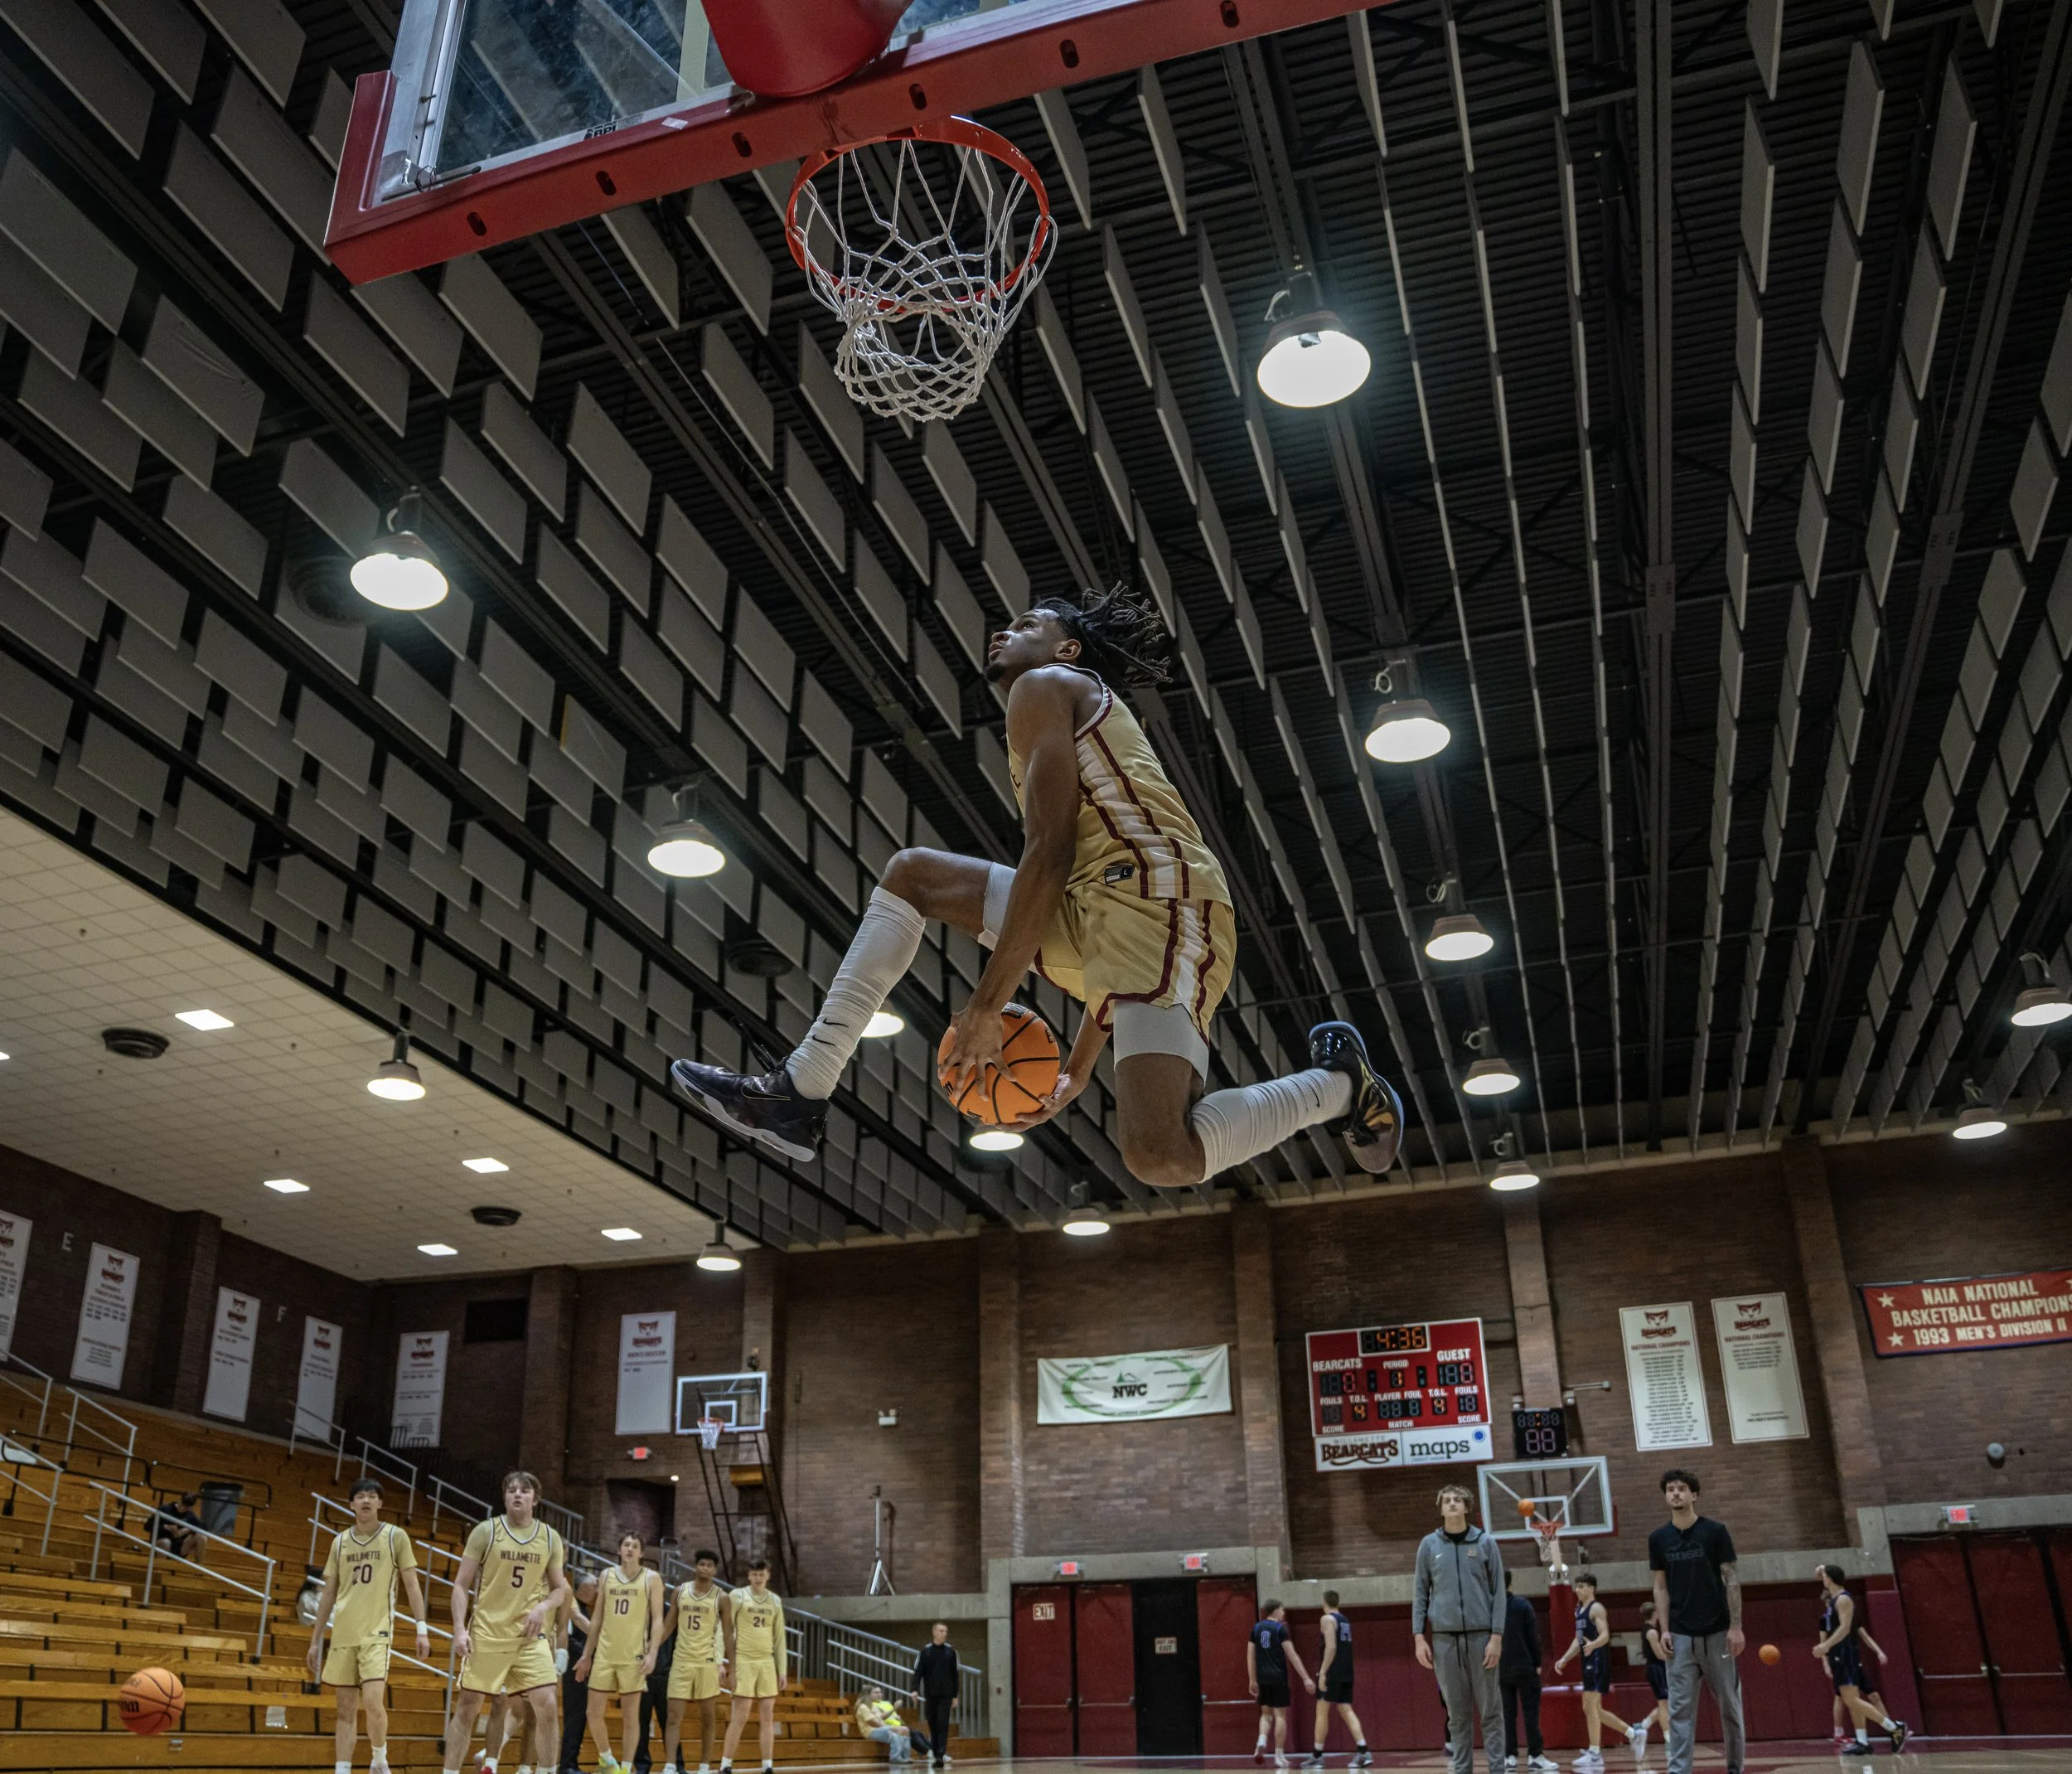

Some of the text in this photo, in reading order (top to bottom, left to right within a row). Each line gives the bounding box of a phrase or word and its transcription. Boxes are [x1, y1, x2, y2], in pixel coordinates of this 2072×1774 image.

[62, 1232, 73, 1251] E
[1922, 1279, 2039, 1306] NAIA NATIONAL
[277, 1306, 288, 1322] F
[1890, 1306, 1986, 1327] BASKETBALL
[1376, 1326, 1426, 1349] 4:36
[1913, 1328, 1950, 1345] 1993
[1955, 1325, 1996, 1342] MEN'S
[2000, 1320, 2053, 1338] DIVISION
[1437, 1349, 1471, 1361] GUEST
[1313, 1357, 1362, 1372] BEARCATS
[1383, 1360, 1409, 1369] PERIOD
[1112, 1384, 1147, 1398] NWC
[1374, 1390, 1422, 1401] PLAYER FOUL
[1455, 1385, 1479, 1395] FOULS
[1320, 1396, 1343, 1405] FOULS
[1388, 1420, 1414, 1429] MATCH
[1457, 1415, 1481, 1423] SCORE
[1322, 1425, 1343, 1433] SCORE
[1321, 1439, 1398, 1462] BEARCATS
[1410, 1440, 1470, 1458] maps
[346, 1550, 381, 1563] WILLAMETTE
[500, 1550, 541, 1564] WILLAMETTE
[511, 1566, 525, 1588] 5
[609, 1588, 638, 1597] WILLAMETTE
[615, 1598, 629, 1615] 10
[1034, 1604, 1053, 1619] EXIT
[688, 1615, 701, 1631] 15
[1261, 1630, 1271, 1649] 0
